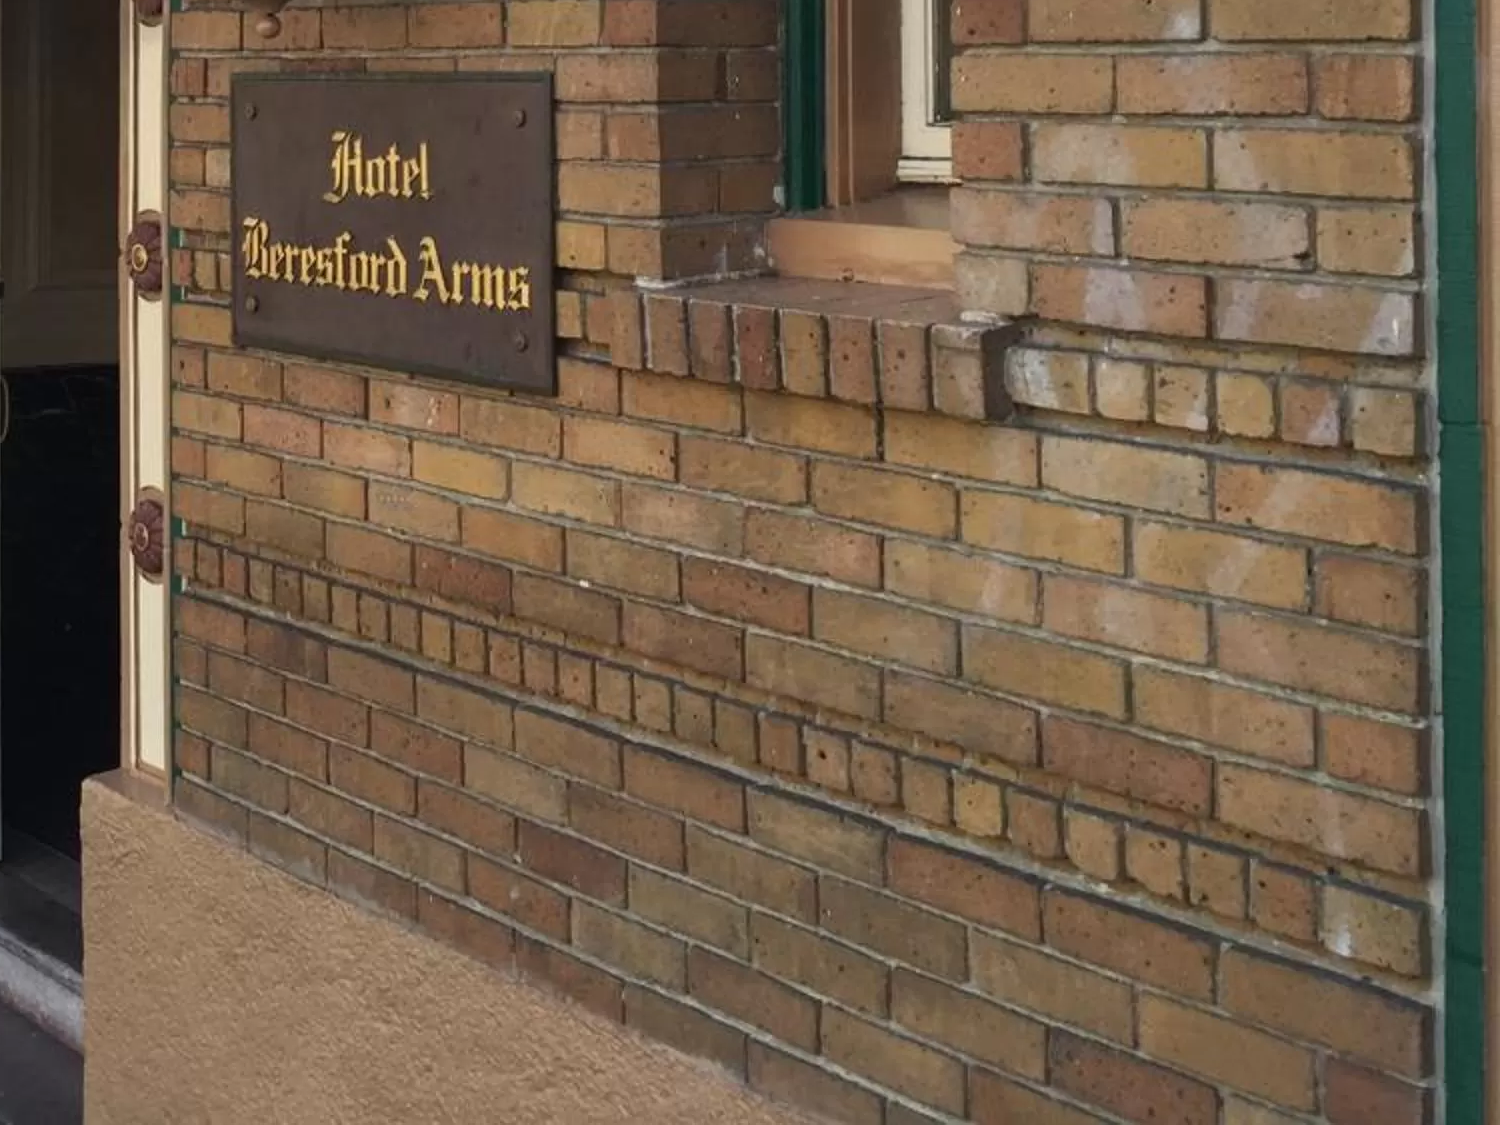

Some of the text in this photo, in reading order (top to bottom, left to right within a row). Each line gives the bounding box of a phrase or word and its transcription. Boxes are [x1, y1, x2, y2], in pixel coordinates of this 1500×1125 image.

[323, 130, 434, 204] Hotel
[242, 216, 531, 311] Beresford Arms
